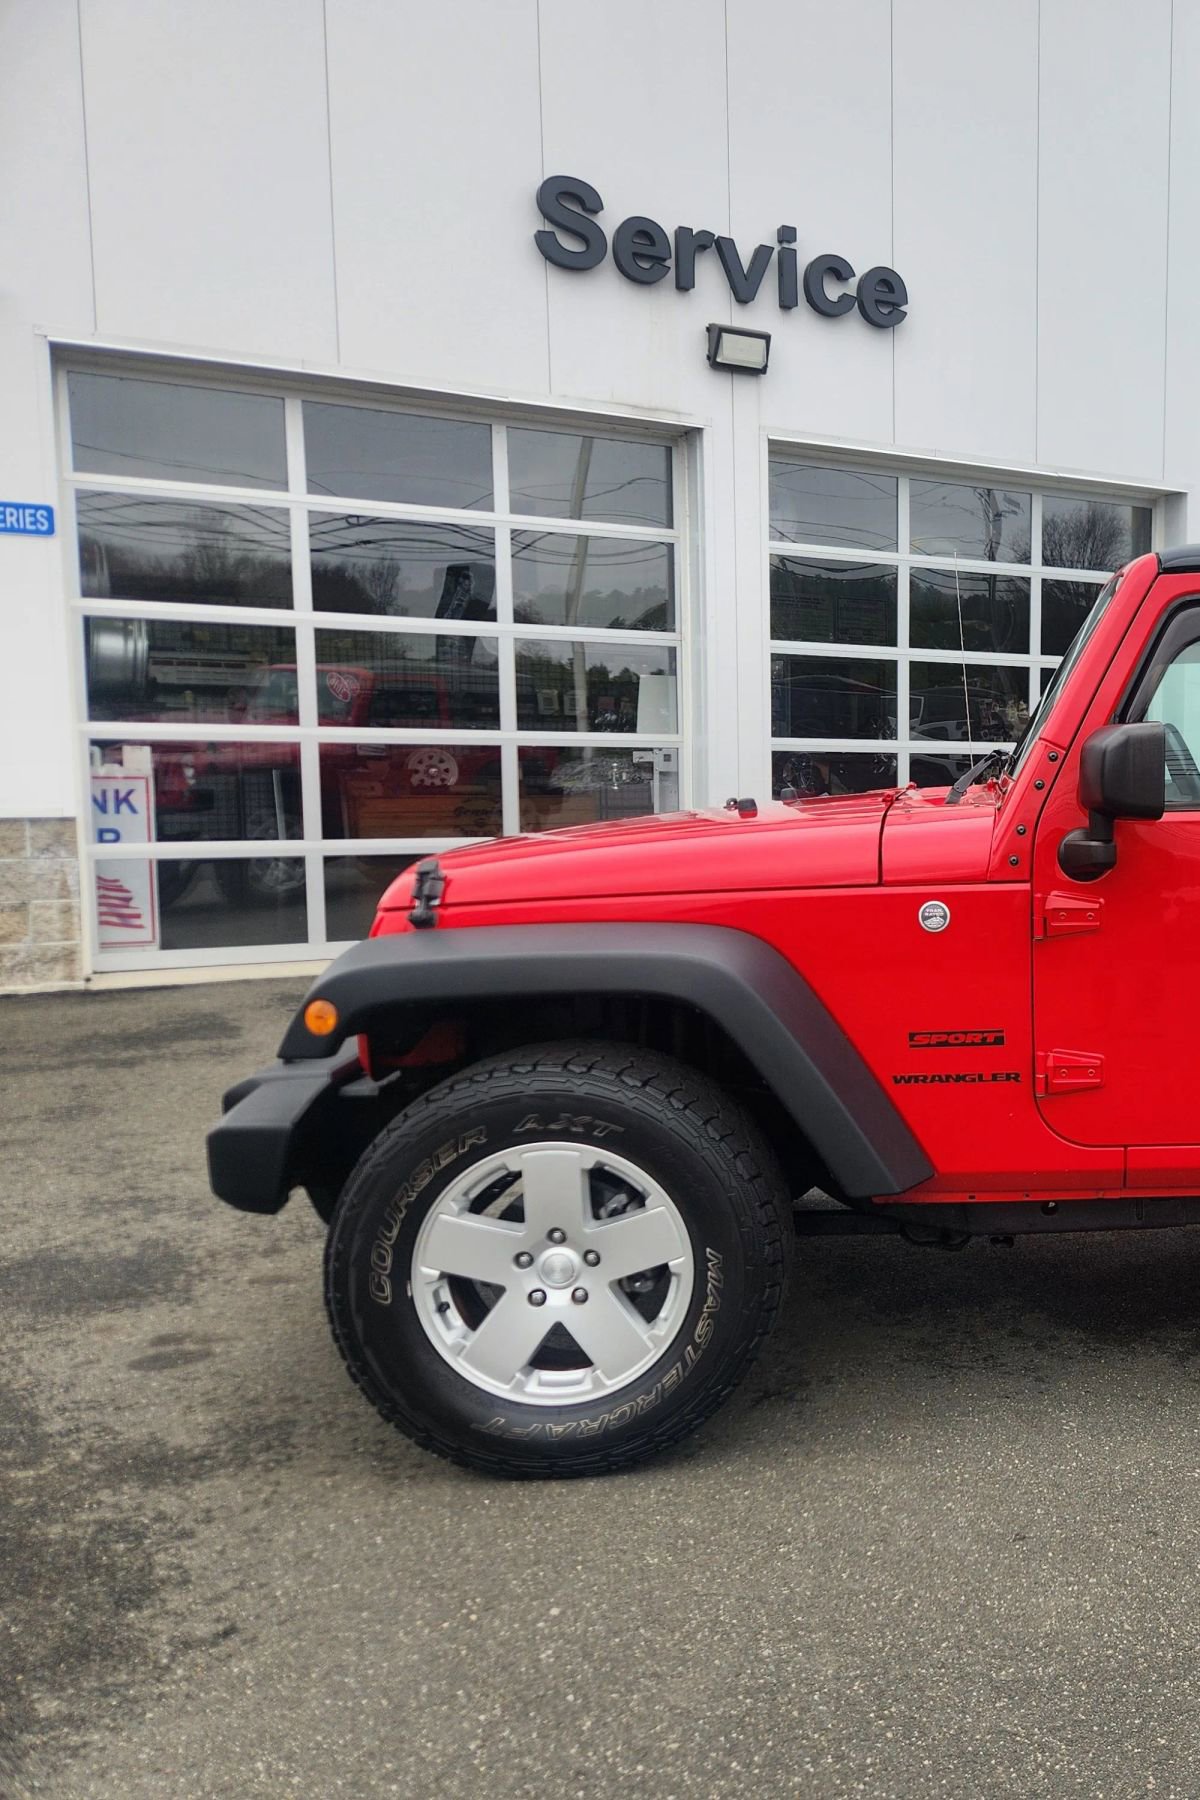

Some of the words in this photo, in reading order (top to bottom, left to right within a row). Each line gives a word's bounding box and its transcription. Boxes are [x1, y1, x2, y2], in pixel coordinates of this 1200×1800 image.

[534, 175, 908, 329] Service
[892, 1072, 1022, 1085] WRANGLER
[910, 1032, 1001, 1045] SPORT
[369, 1125, 488, 1305] COURSER
[513, 1113, 626, 1137] AXT
[470, 1247, 725, 1440] MASTERCRAFT
